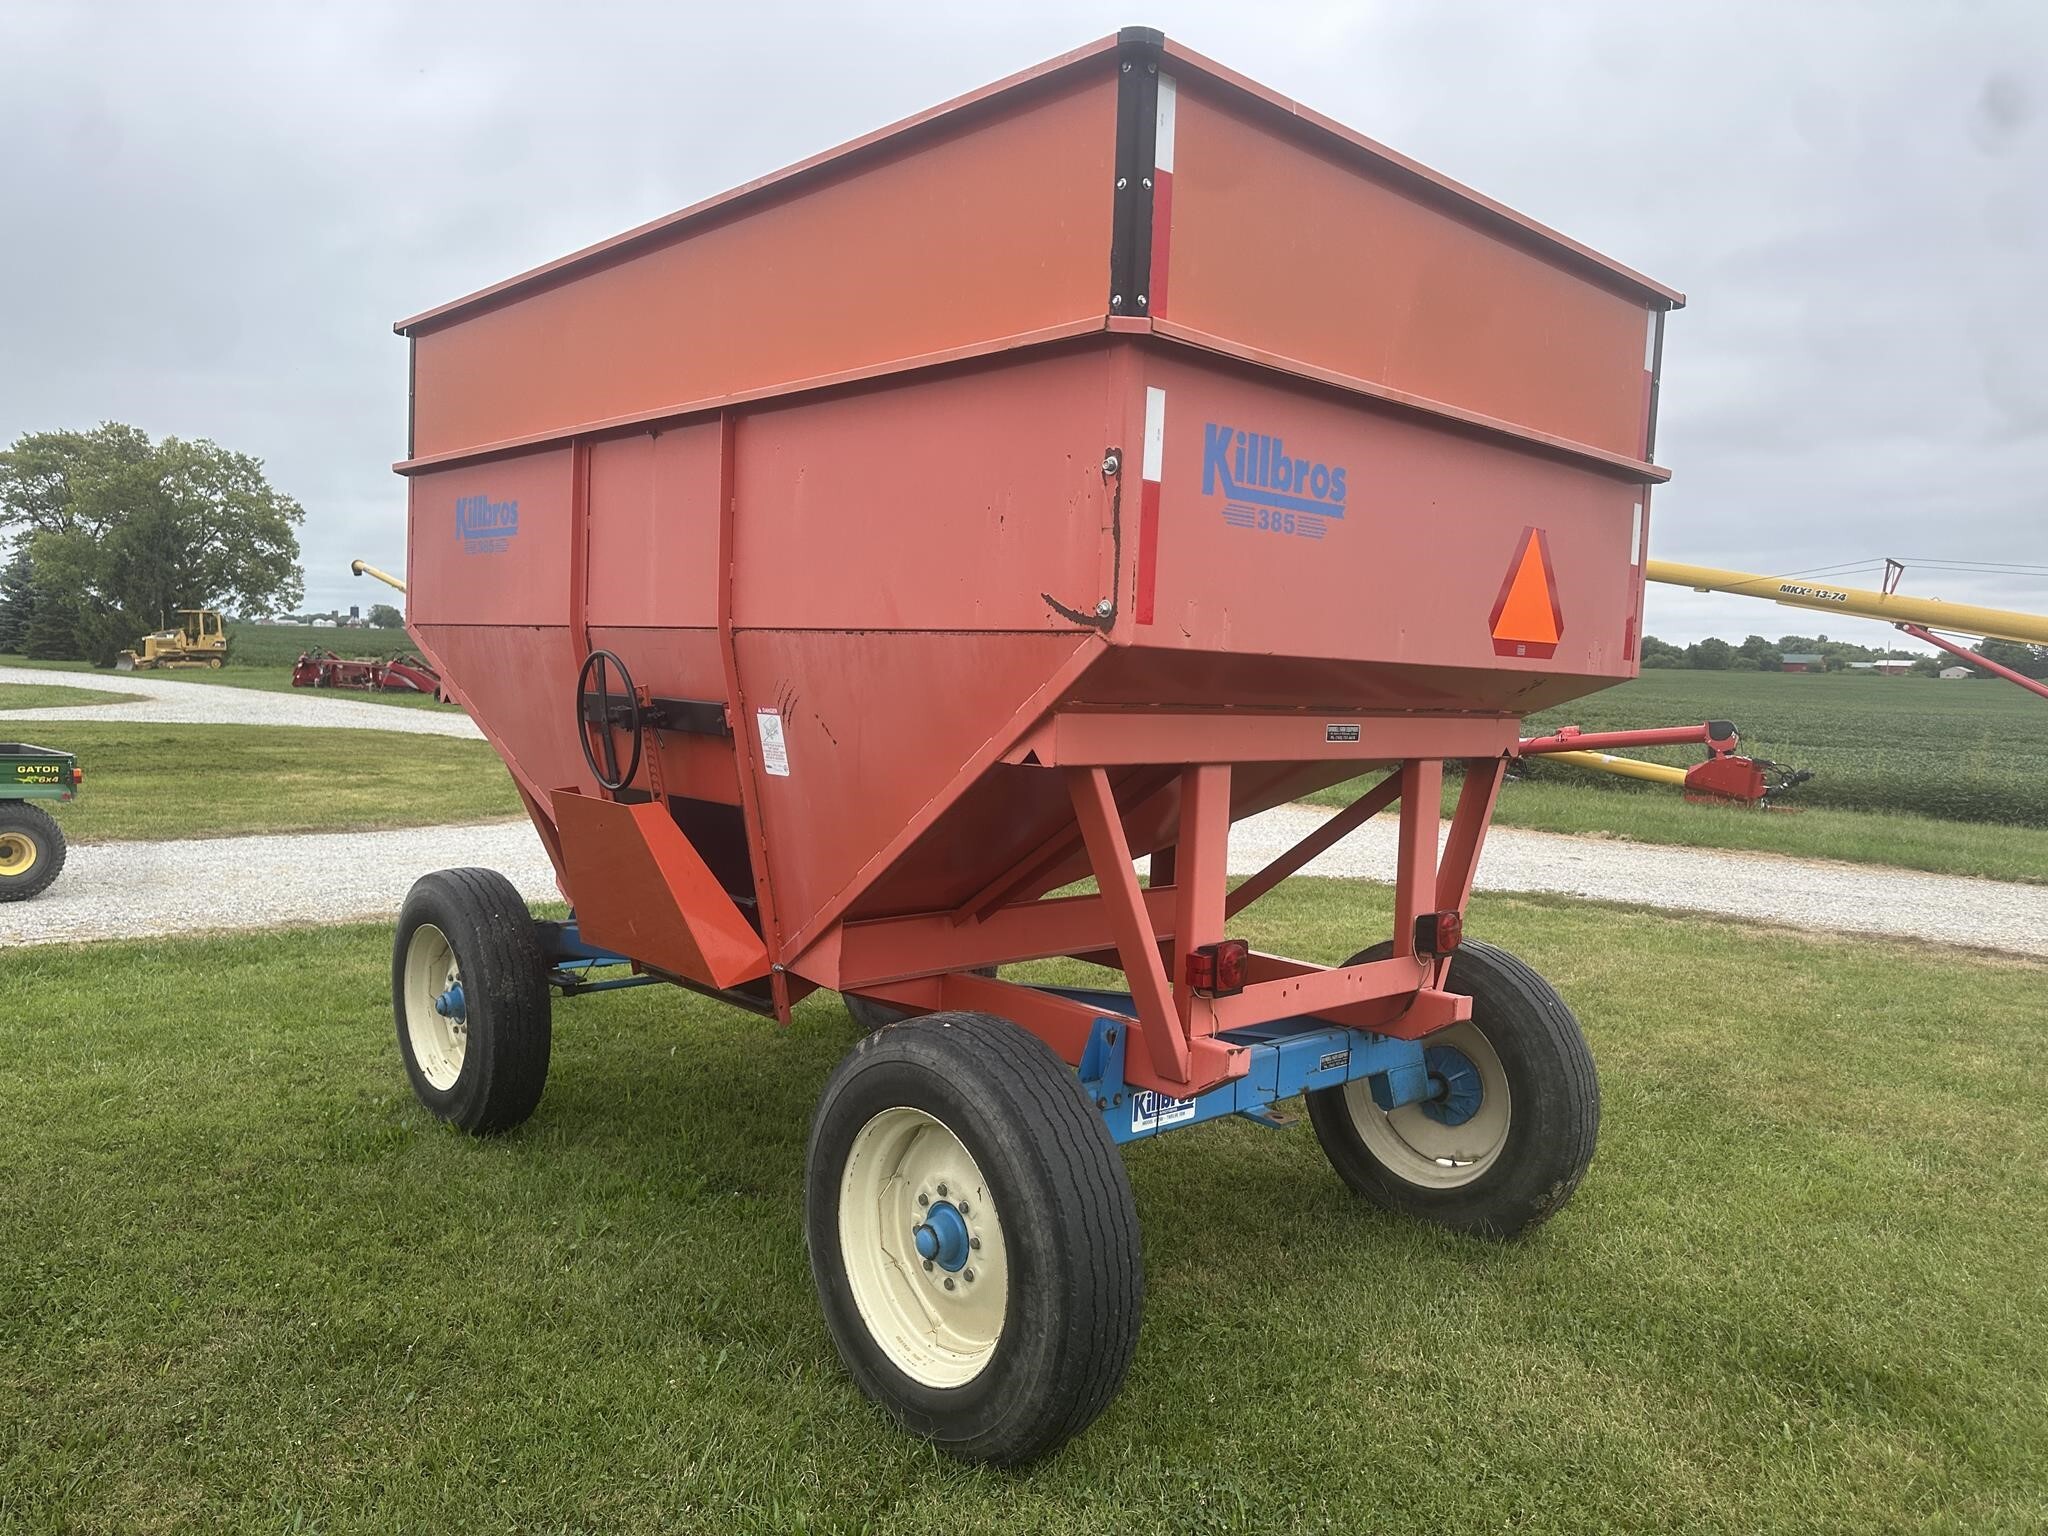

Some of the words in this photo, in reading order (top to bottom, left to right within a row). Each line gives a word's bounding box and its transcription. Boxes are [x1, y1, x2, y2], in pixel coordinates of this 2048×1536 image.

[1202, 422, 1346, 502] Killbros
[455, 495, 518, 541] Killbros
[1258, 509, 1295, 534] 385
[1815, 590, 1847, 601] 13-74
[1133, 1091, 1194, 1122] Killbr
